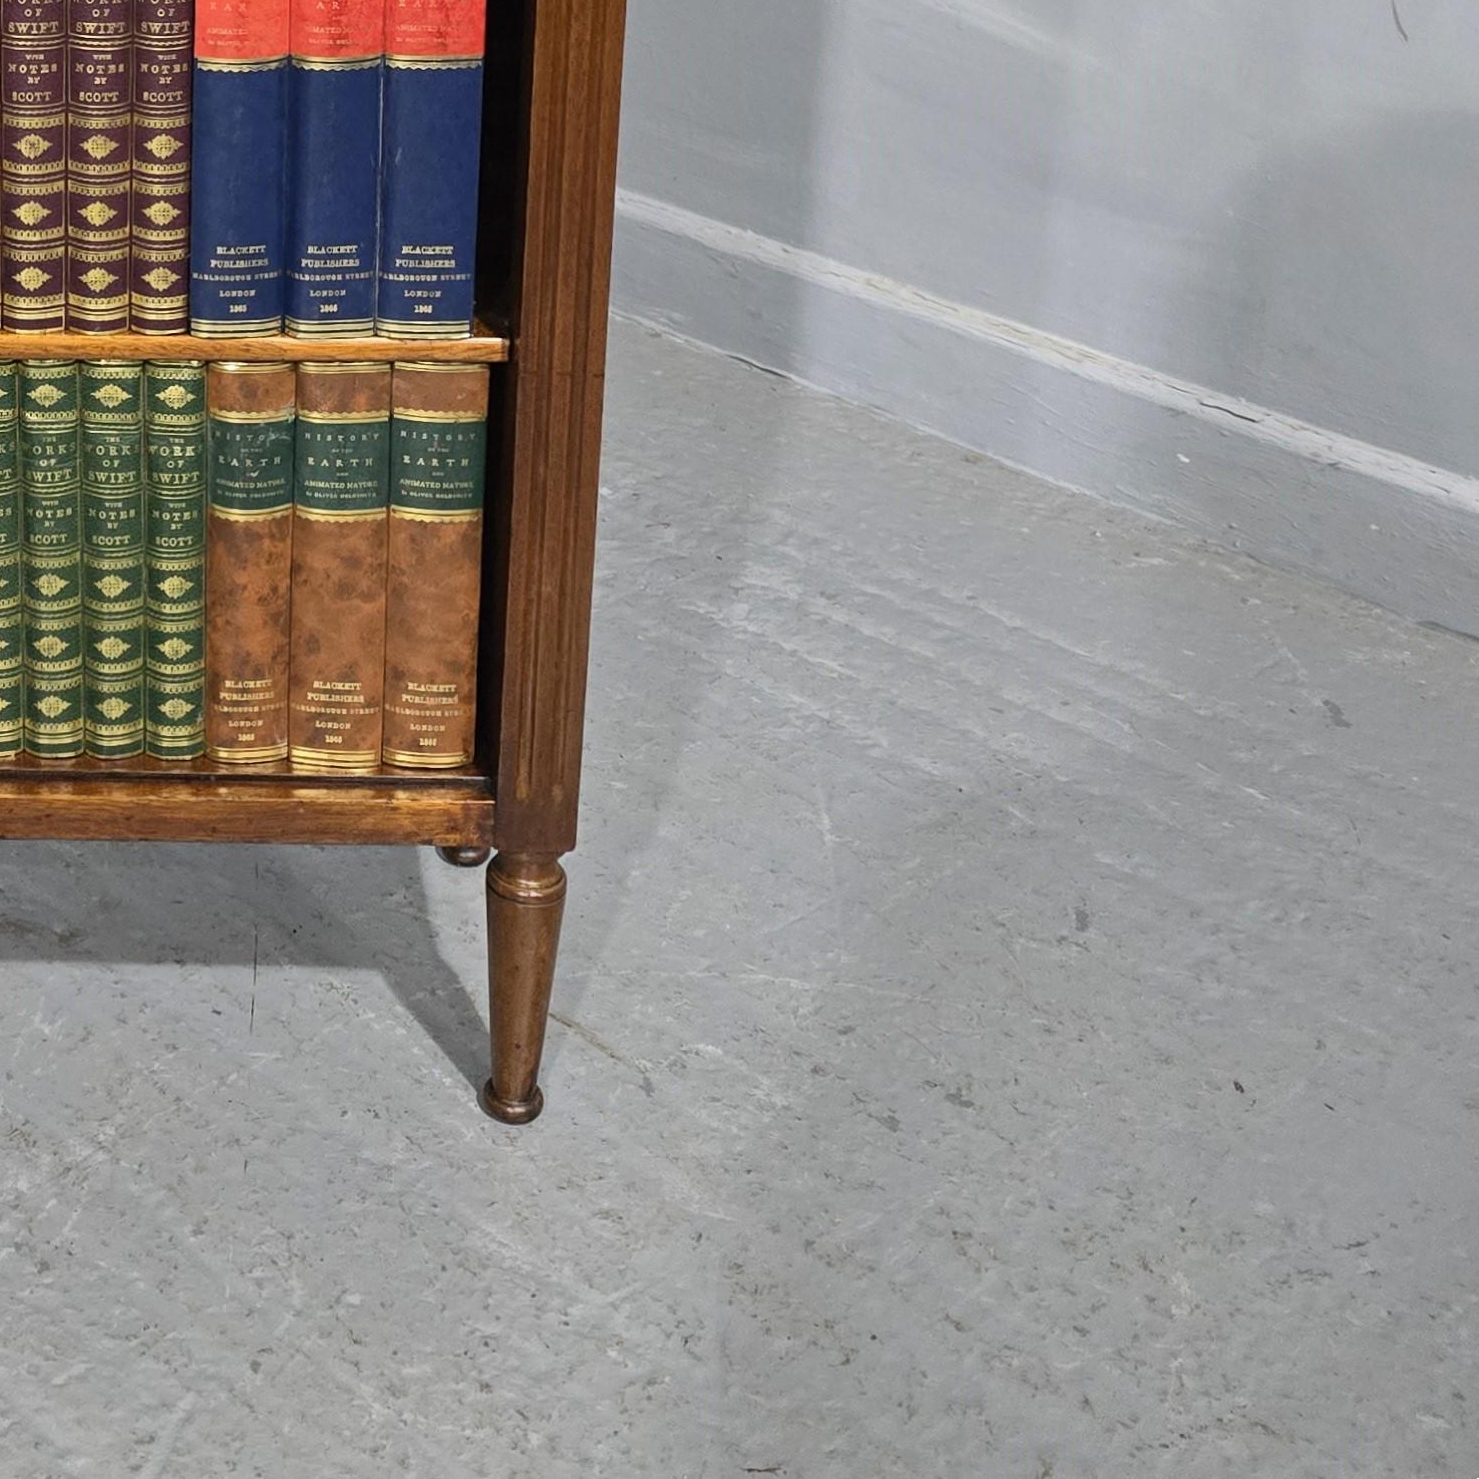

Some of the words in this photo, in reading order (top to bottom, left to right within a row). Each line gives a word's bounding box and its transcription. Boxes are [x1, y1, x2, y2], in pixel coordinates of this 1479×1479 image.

[24, 8, 42, 17] OF
[8, 22, 59, 34] SWIFT
[75, 22, 126, 34] SWIFT
[140, 21, 191, 34] SWIFT
[8, 63, 58, 74] NOTES
[75, 63, 125, 74] NOTES
[140, 63, 188, 74] NOTES
[12, 91, 52, 102] SCOTT
[79, 91, 119, 102] SCOTT
[143, 91, 183, 102] SCOTT
[216, 245, 266, 255] BLACKETT
[307, 245, 358, 255] BLACKETT
[401, 245, 453, 255] BLACKETT
[210, 258, 269, 268] PUBLISHERS
[301, 258, 360, 268] PUBLISHERS
[395, 258, 456, 268] PUBLISHERS
[219, 289, 256, 297] LONDON
[310, 289, 346, 297] LONDON
[404, 289, 441, 298] LONDON
[304, 432, 379, 442] HISTORY
[400, 430, 476, 441] HISTORY
[307, 457, 373, 467] EARTH
[403, 455, 469, 467] EARTH
[88, 471, 136, 484] SWIFT
[152, 472, 200, 485] SWIFT
[304, 479, 345, 489] ANIMATED
[399, 478, 441, 489] ANIMATED
[30, 533, 67, 544] SCOTT
[92, 535, 131, 545] SCOTT
[155, 536, 194, 547] SCOTT
[307, 692, 364, 703] PUBLISHERS
[228, 719, 263, 727] LONDON
[315, 721, 351, 729] LONDON
